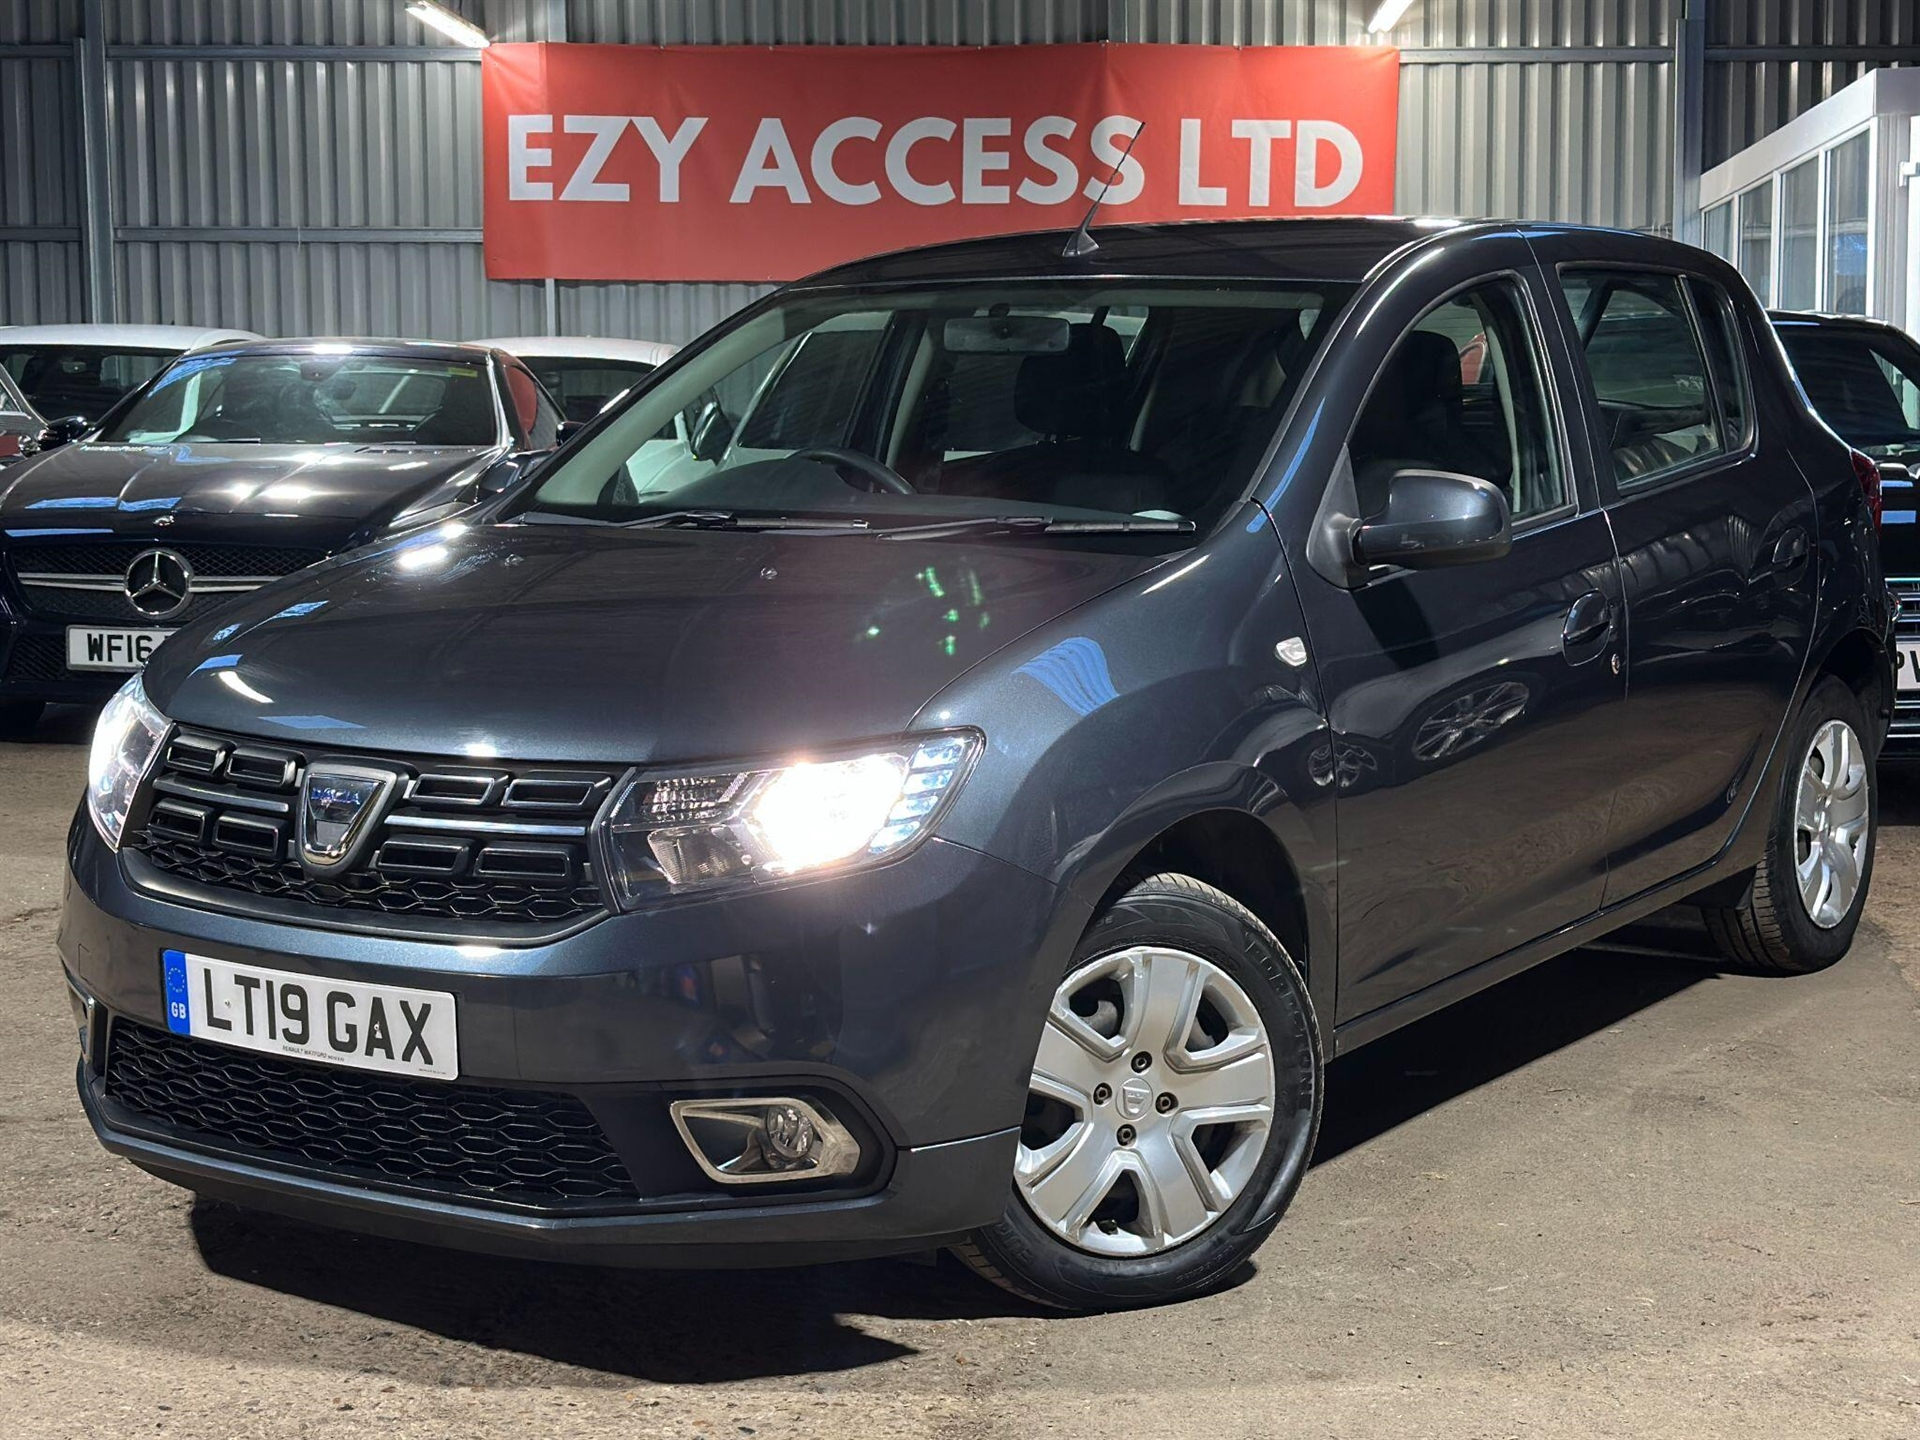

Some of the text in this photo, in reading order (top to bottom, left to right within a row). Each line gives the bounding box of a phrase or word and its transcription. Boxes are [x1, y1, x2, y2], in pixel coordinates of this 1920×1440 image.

[508, 114, 1364, 208] EZY ACCESS LTD
[87, 633, 153, 663] WF16
[171, 1001, 186, 1019] GB
[203, 968, 434, 1066] LT19 GAX
